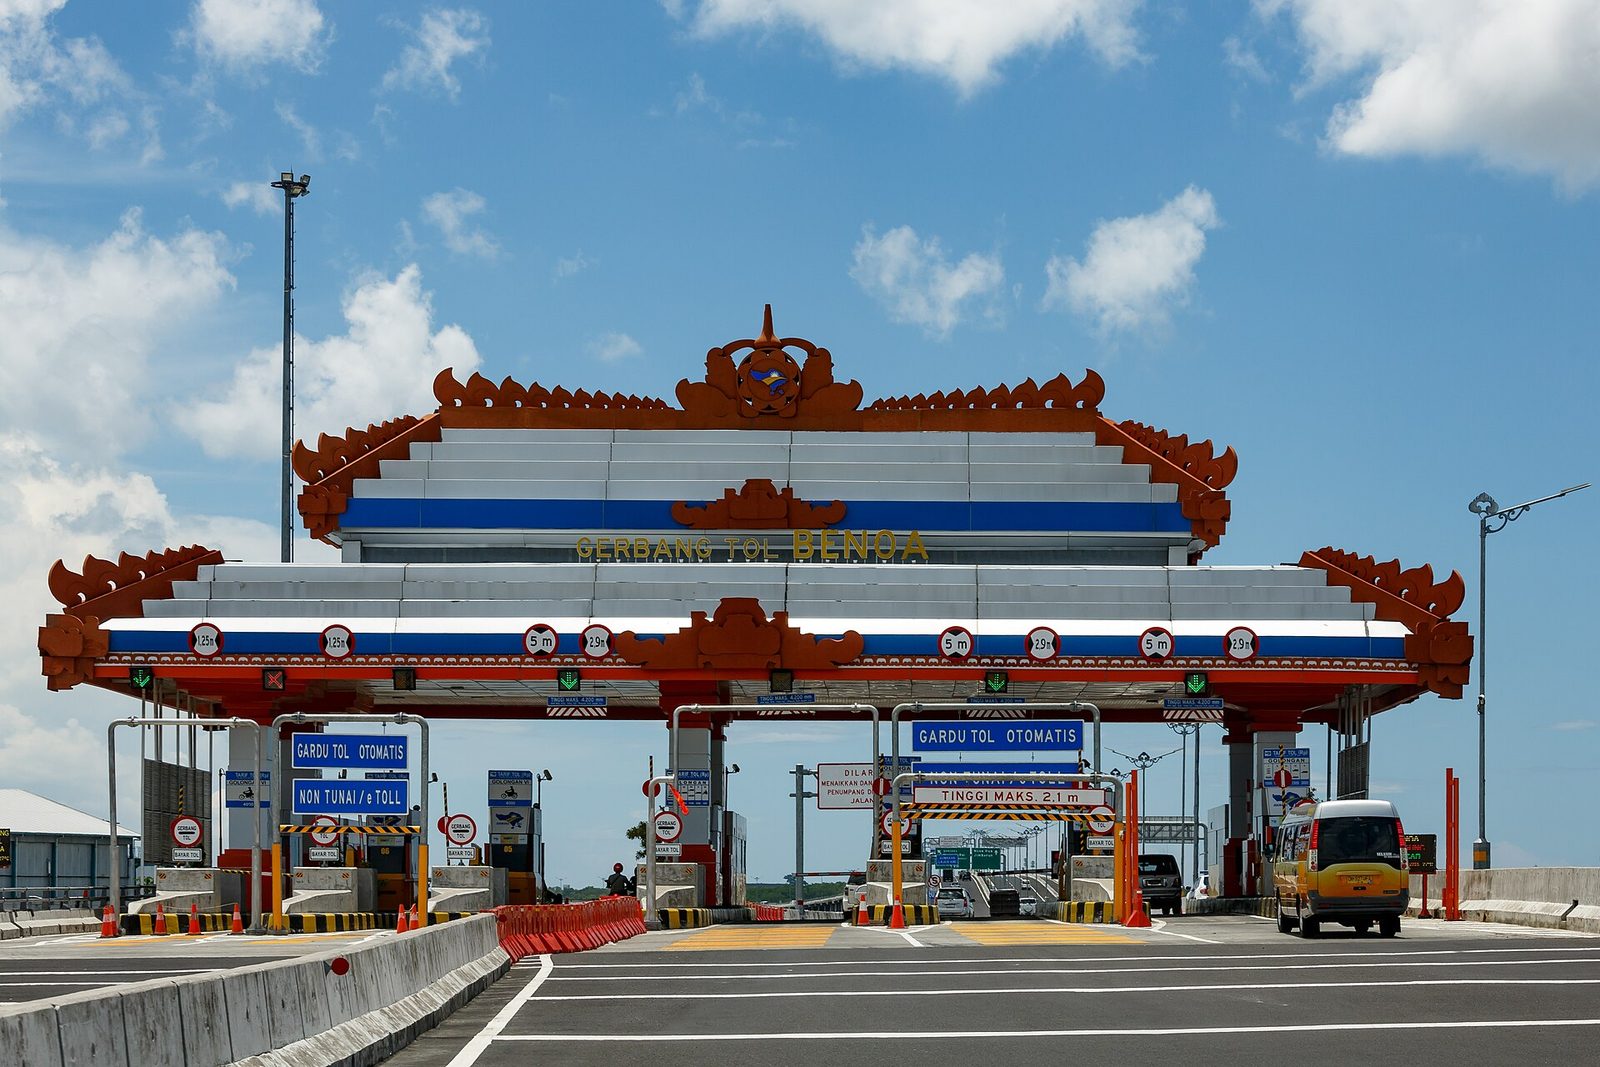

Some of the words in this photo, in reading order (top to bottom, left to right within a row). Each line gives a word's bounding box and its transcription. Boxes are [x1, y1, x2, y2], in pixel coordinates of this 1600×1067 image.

[575, 536, 713, 558] GERBANG
[724, 537, 779, 558] TOL
[792, 529, 929, 560] BENOA
[919, 730, 966, 743] GARDU
[971, 730, 995, 743] TOL
[1006, 729, 1076, 743] OTOMATIS
[297, 743, 329, 759] GARDU
[333, 744, 349, 759] TOL
[359, 744, 404, 760] OTOMATIS
[300, 789, 320, 804] NON
[325, 790, 356, 804] TUNAI
[376, 790, 400, 804] TOLL
[942, 790, 988, 801] TINGGI
[994, 792, 1038, 802] MAKS.
